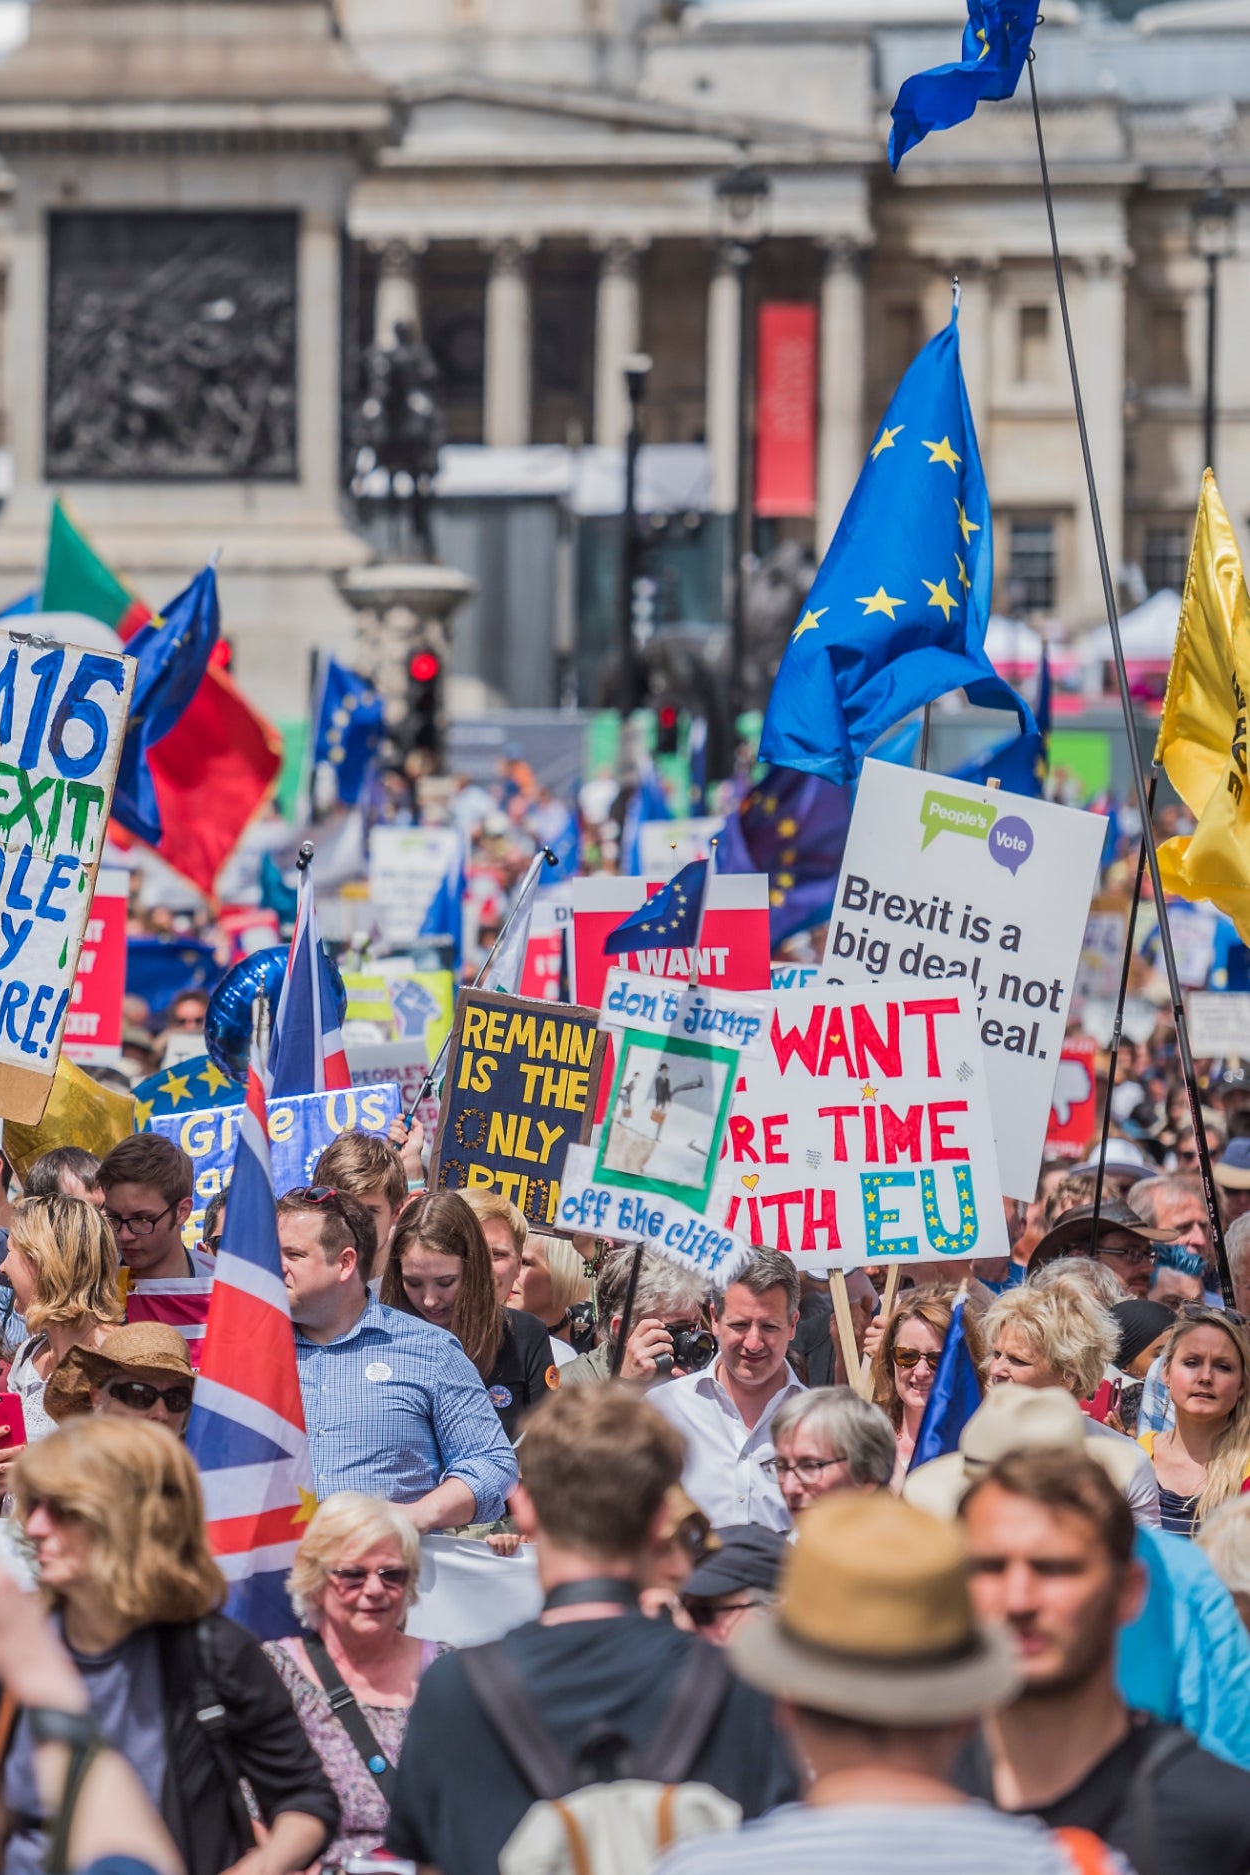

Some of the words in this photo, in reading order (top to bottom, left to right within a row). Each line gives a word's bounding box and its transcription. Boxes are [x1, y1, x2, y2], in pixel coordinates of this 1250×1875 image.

[17, 650, 126, 780] 16
[929, 801, 988, 829] People's
[995, 831, 1028, 852] Vote
[841, 874, 954, 935] Brexit
[959, 905, 992, 943] is
[999, 924, 1022, 952] a
[636, 947, 730, 976] WANT
[832, 921, 891, 975] big
[998, 972, 1064, 1013] not
[461, 1005, 598, 1068] REMAIN
[608, 981, 679, 1023] don't
[684, 997, 763, 1047] jump
[770, 997, 961, 1080] WANT
[977, 1008, 1047, 1060] eal.
[457, 1051, 499, 1093] IS
[519, 1063, 590, 1113] THE
[454, 1106, 566, 1165] ONLY
[818, 1100, 971, 1165] TIME
[561, 1188, 613, 1228] off
[618, 1196, 666, 1237] the
[664, 1217, 736, 1272] cliff
[859, 1164, 979, 1257] EU
